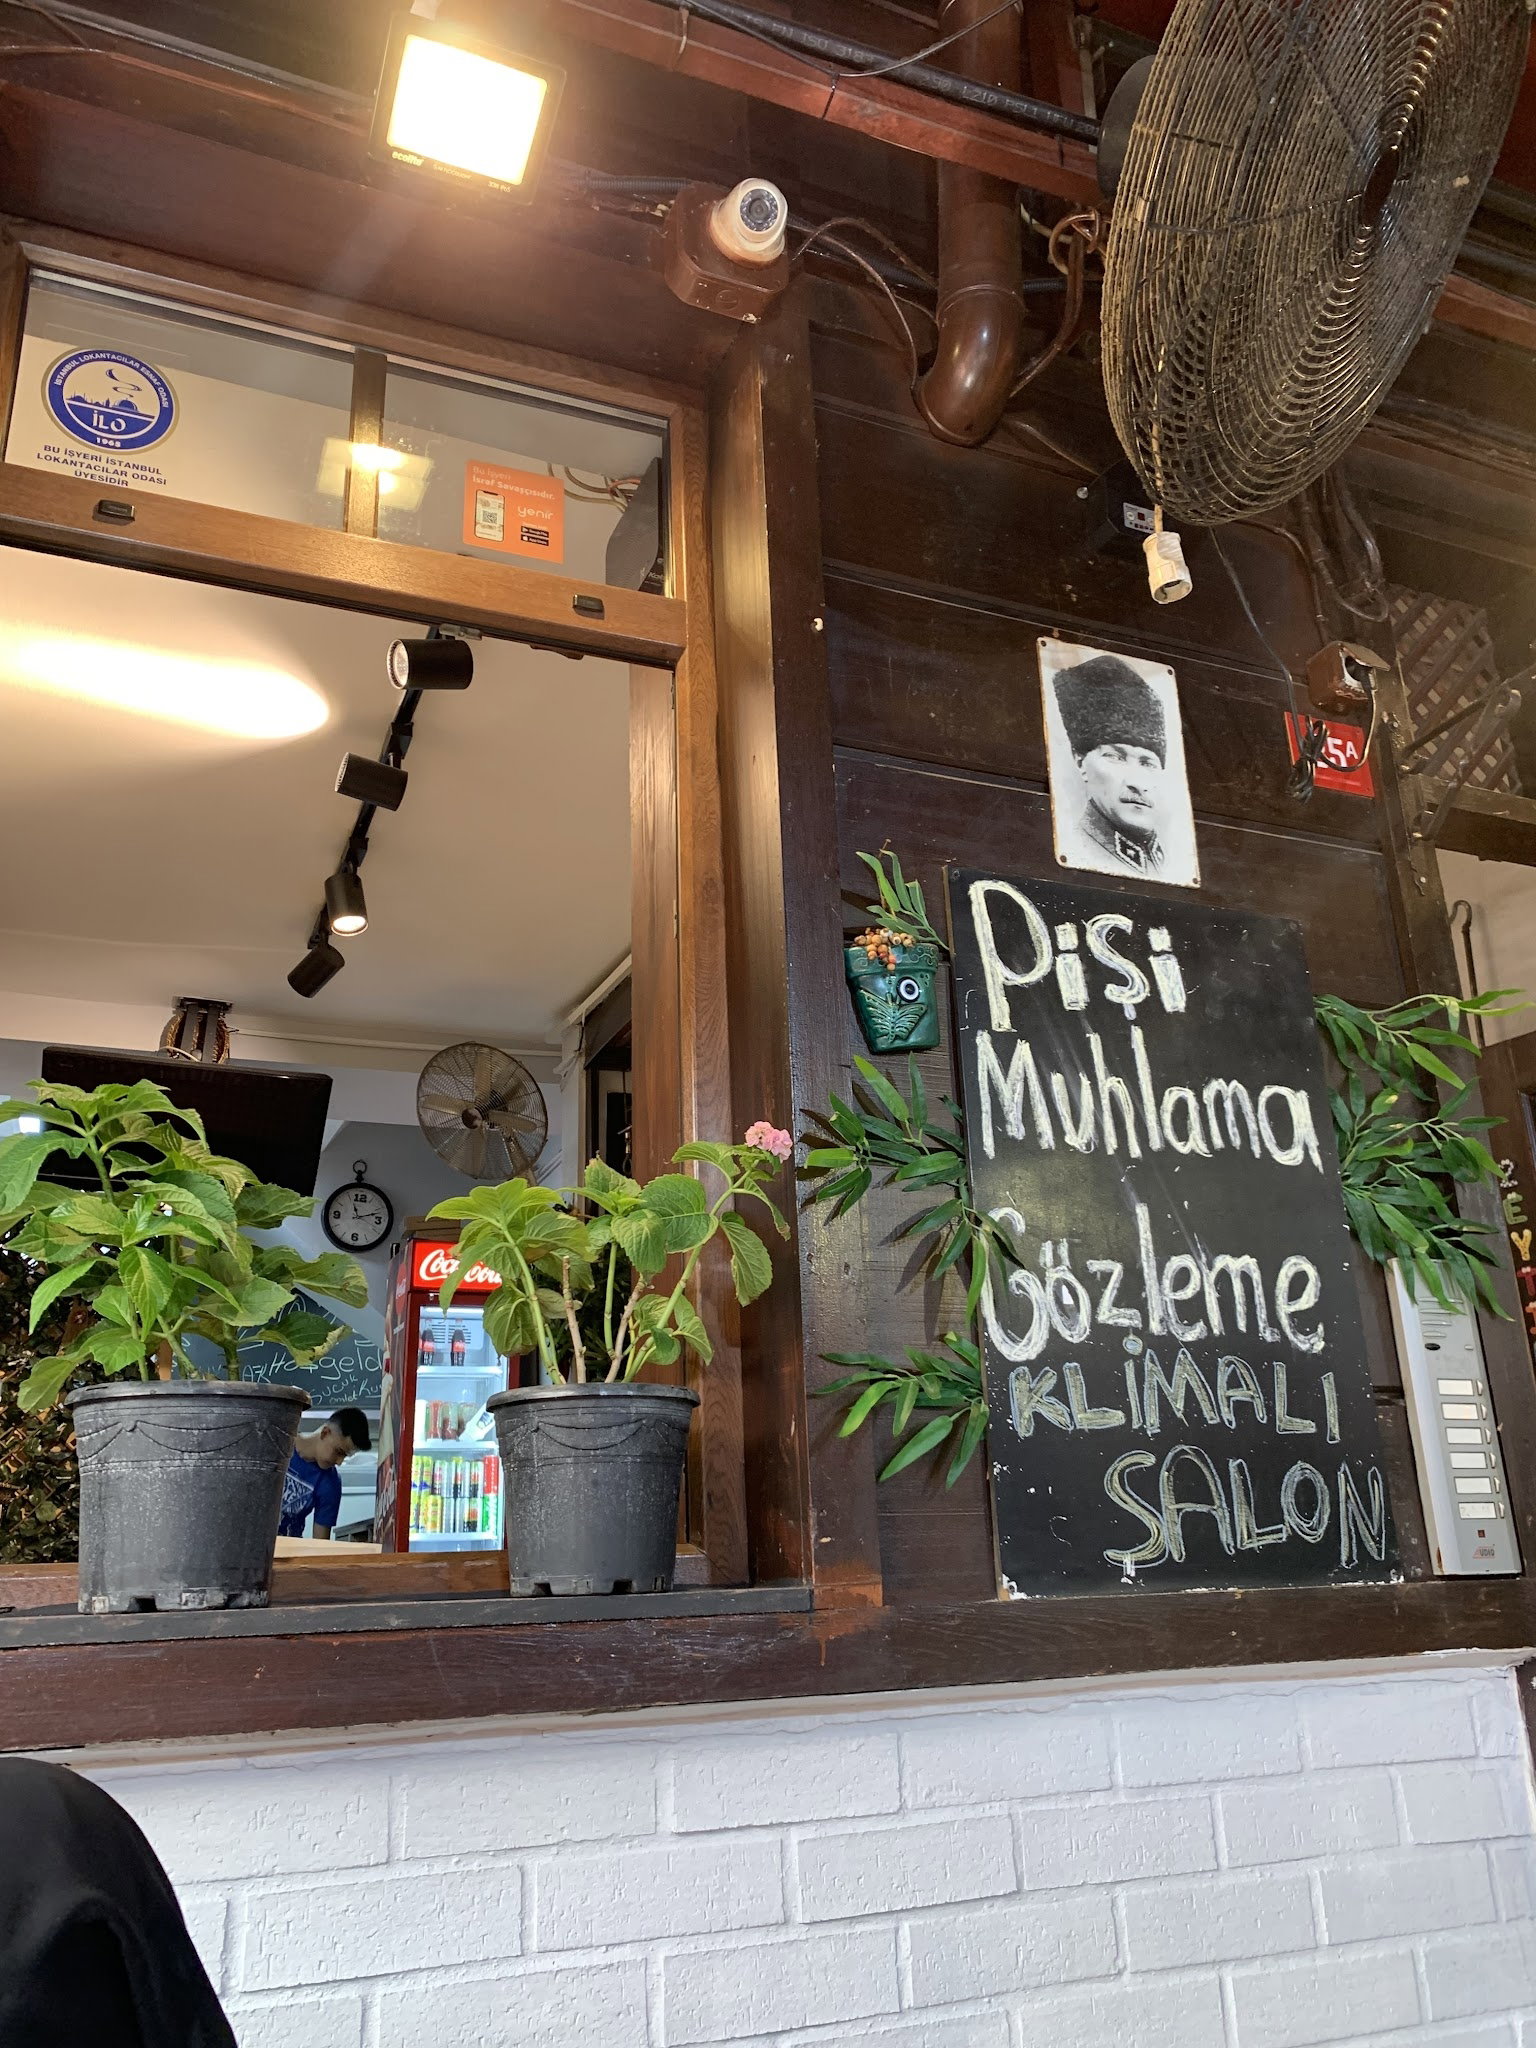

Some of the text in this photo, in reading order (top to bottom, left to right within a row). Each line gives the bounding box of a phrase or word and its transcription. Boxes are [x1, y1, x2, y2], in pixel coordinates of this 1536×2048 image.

[801, 33, 828, 50] ISO
[92, 410, 126, 432] İLO
[36, 453, 167, 485] LOKANTACILAR ODASI
[43, 444, 162, 475] BU İŞYERİ İSTANBUL
[74, 468, 129, 487] ÜYESİDİR
[517, 506, 554, 520] yenir
[975, 1025, 1325, 1174] Muhlama
[353, 1193, 367, 1203] 12
[333, 1210, 341, 1219] 9
[374, 1216, 382, 1225] 3
[351, 1232, 359, 1242] 6
[979, 1203, 1326, 1362] Gözleme
[1008, 1335, 1342, 1443] KLİMALI
